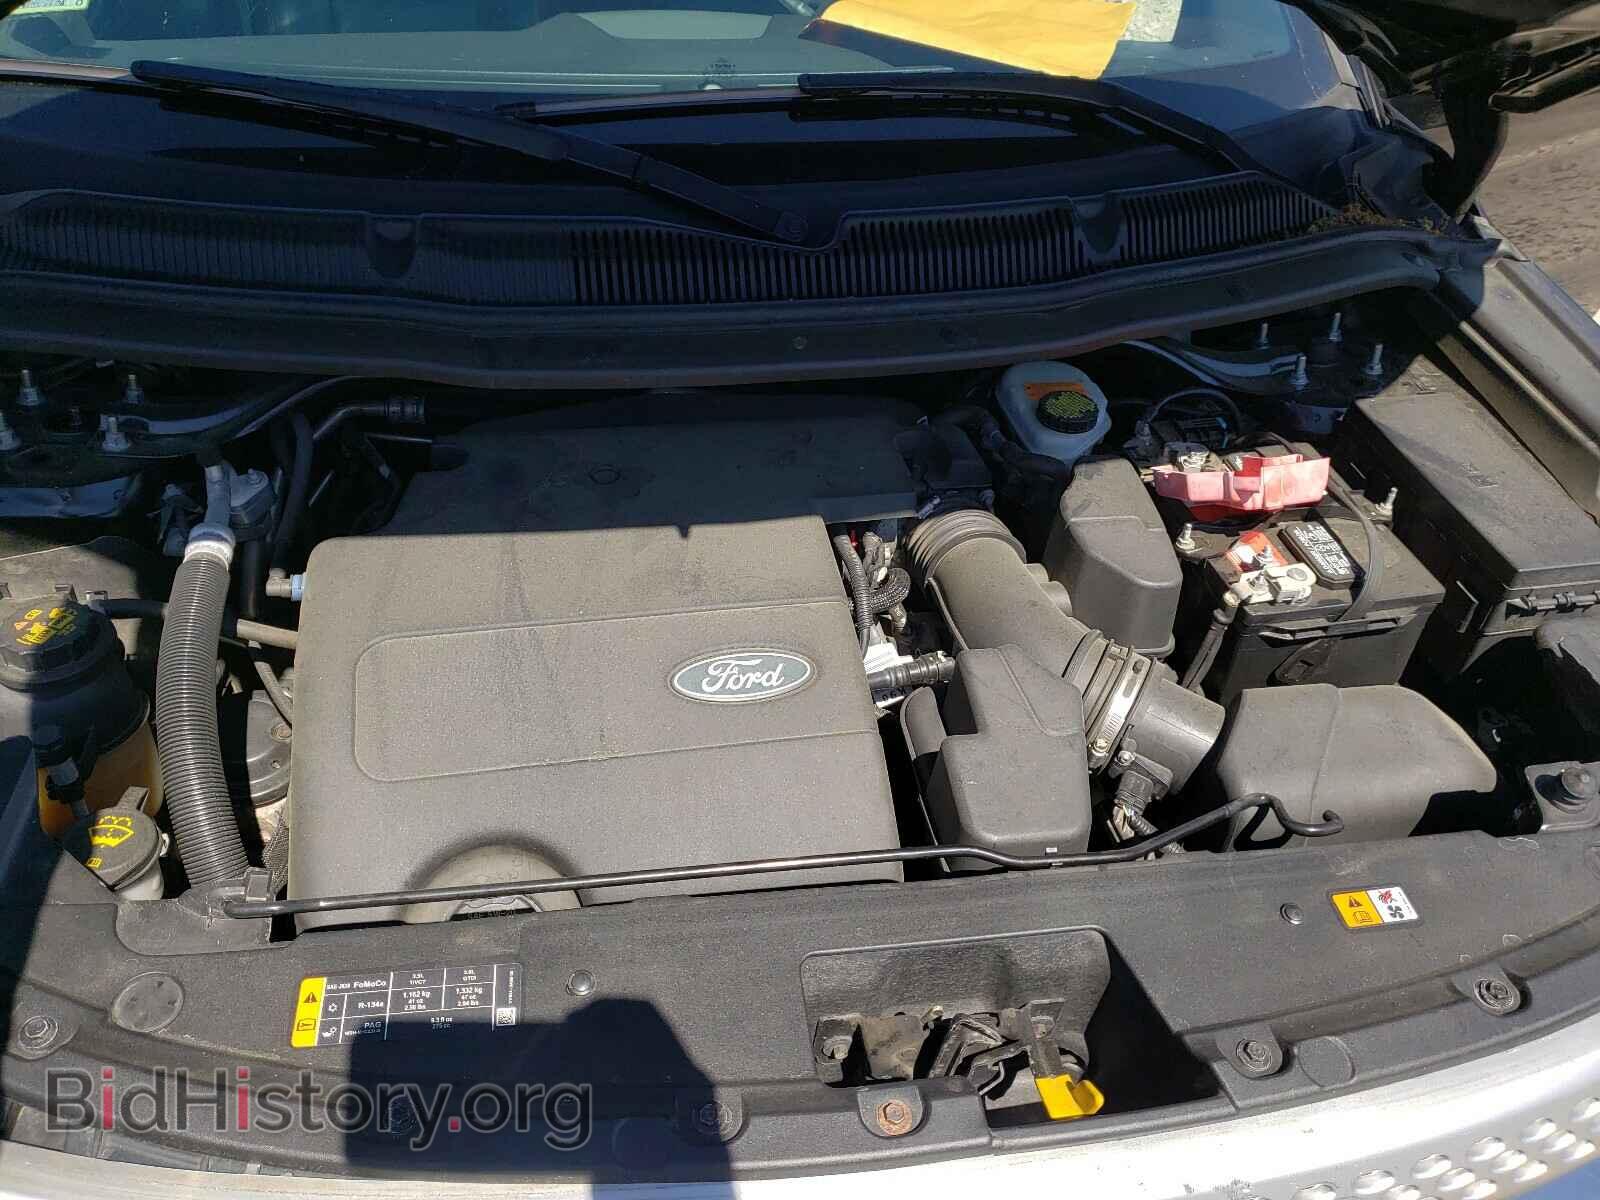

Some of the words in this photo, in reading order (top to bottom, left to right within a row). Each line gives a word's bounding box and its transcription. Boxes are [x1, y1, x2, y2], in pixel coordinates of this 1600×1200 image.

[701, 658, 785, 693] Ford
[353, 979, 387, 989] FoMoCo
[364, 1021, 382, 1029] PAG
